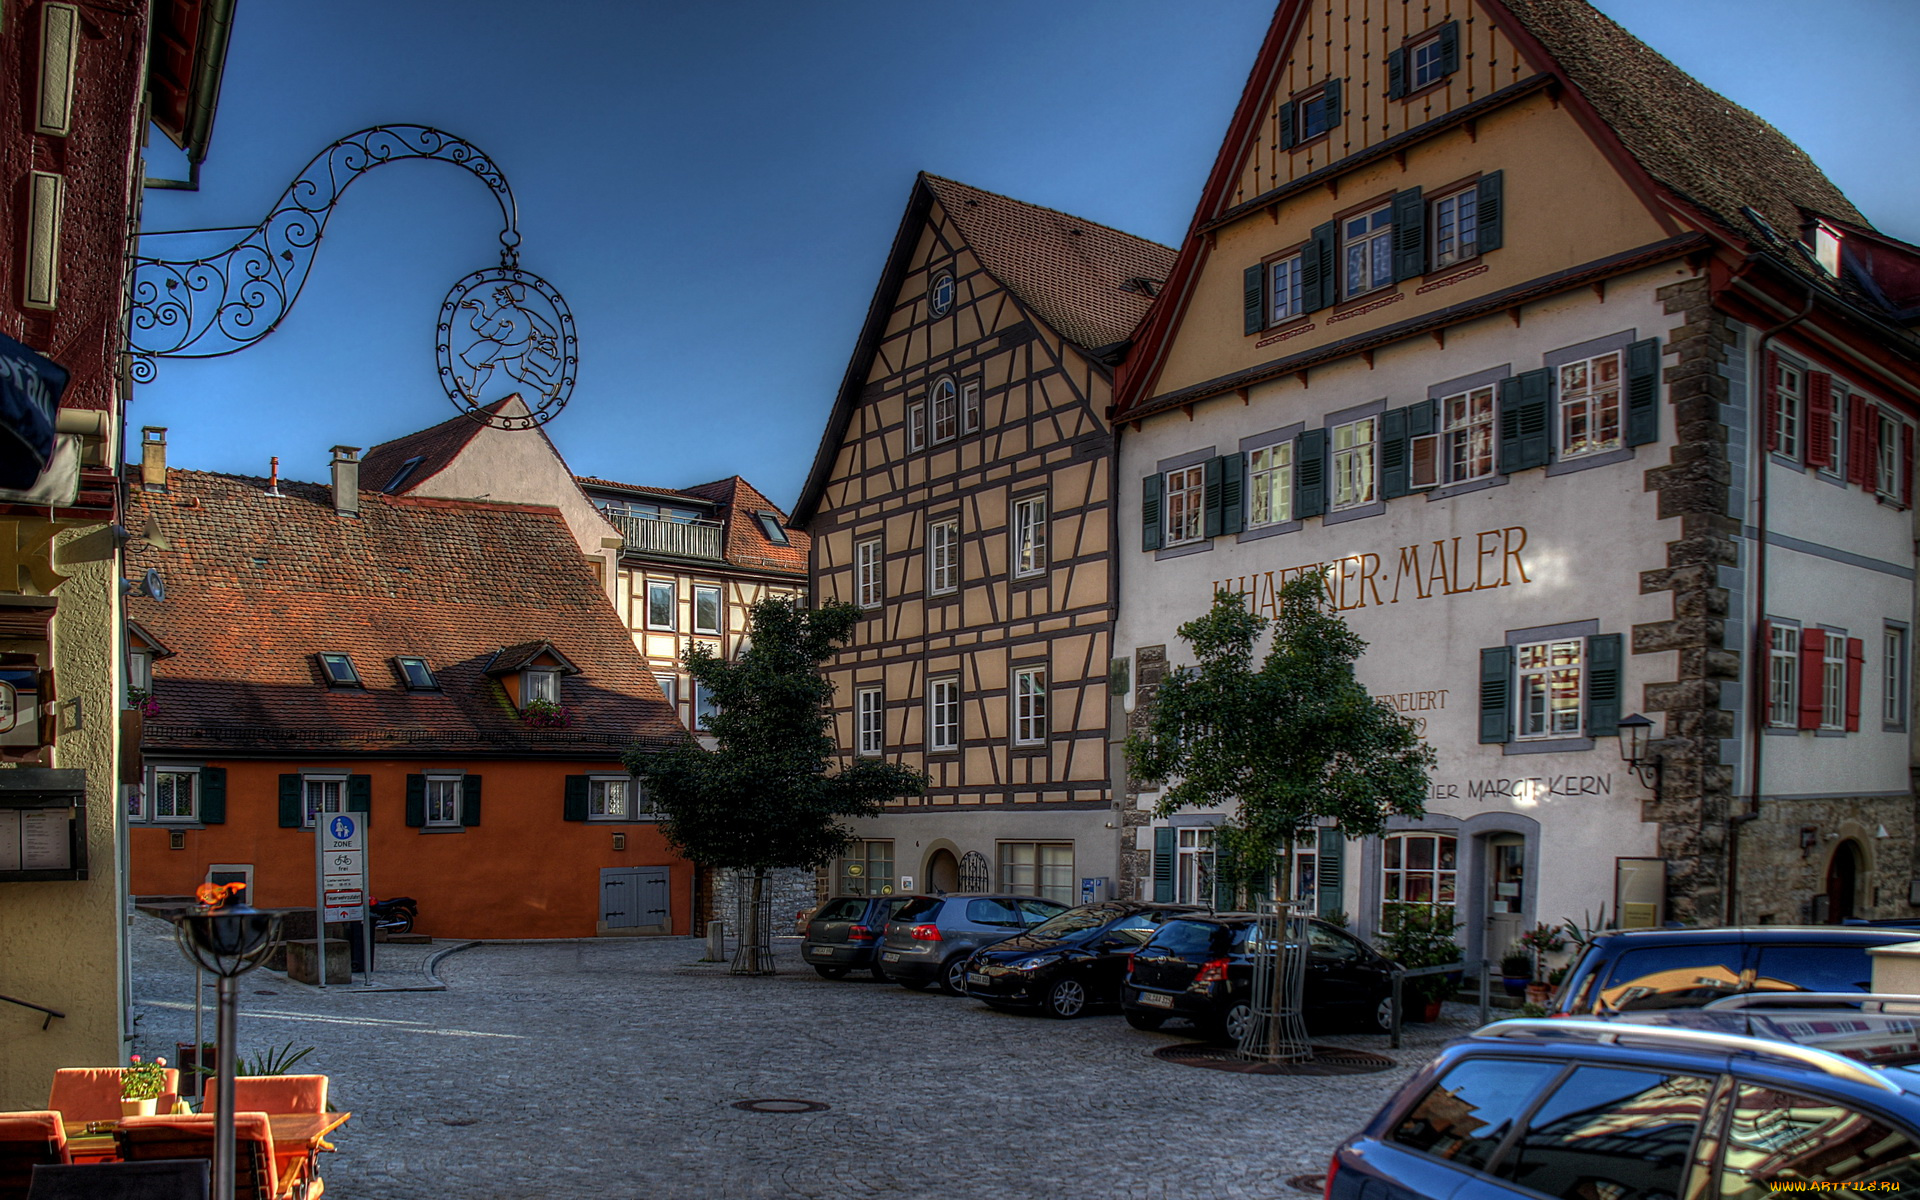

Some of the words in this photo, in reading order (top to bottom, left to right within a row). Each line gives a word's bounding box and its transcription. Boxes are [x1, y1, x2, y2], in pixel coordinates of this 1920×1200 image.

[1391, 526, 1531, 603] MALER
[1468, 777, 1542, 802] MARGIT
[1548, 773, 1611, 796] KERN
